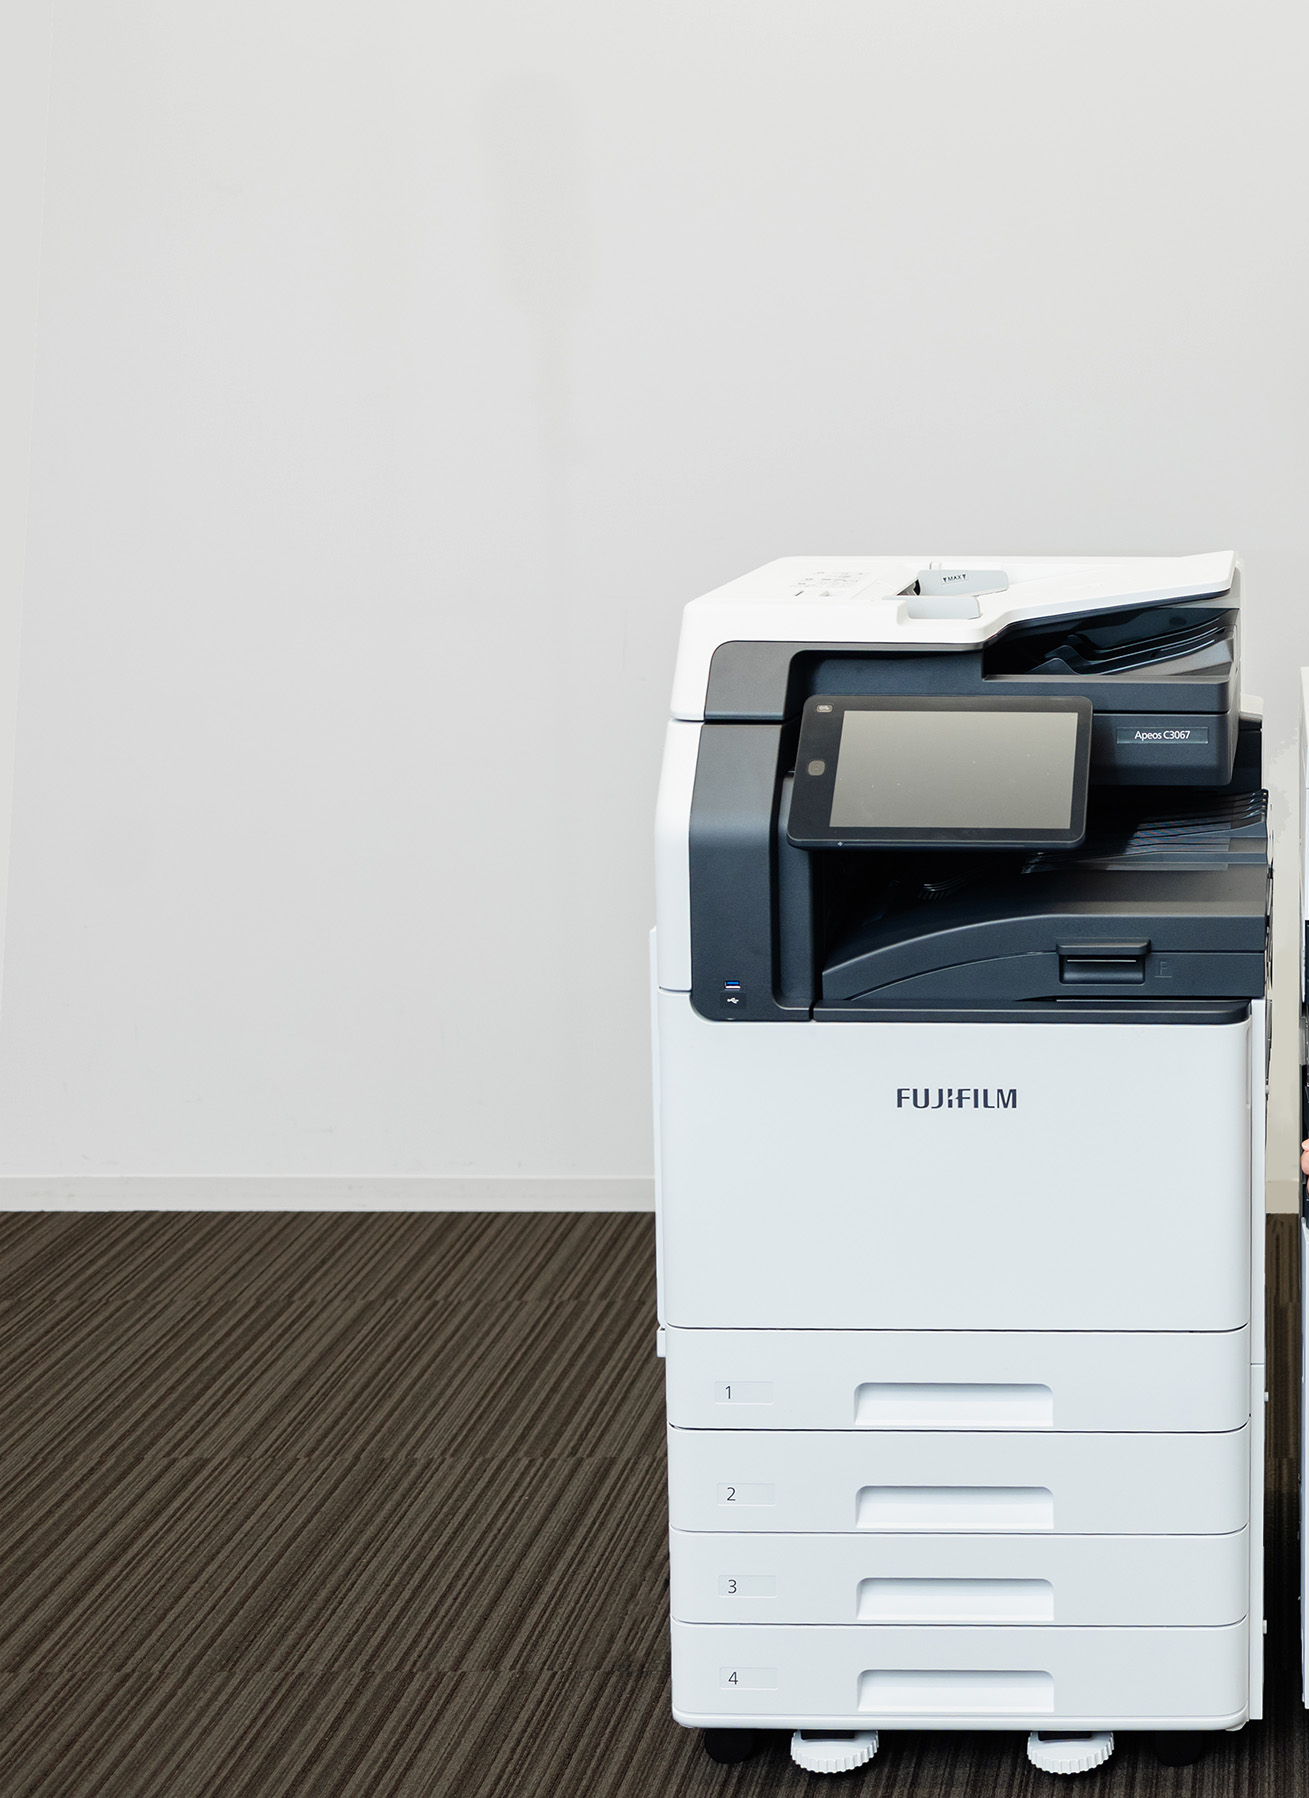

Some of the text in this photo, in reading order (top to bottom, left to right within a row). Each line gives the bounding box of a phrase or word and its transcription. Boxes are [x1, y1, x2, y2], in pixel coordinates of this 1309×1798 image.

[1134, 730, 1191, 742] Apeos C3067
[896, 1087, 1017, 1109] FUJIFILM
[725, 1385, 731, 1400] 1
[727, 1486, 736, 1501] 2
[728, 1579, 737, 1594] 3
[728, 1671, 739, 1685] 4
